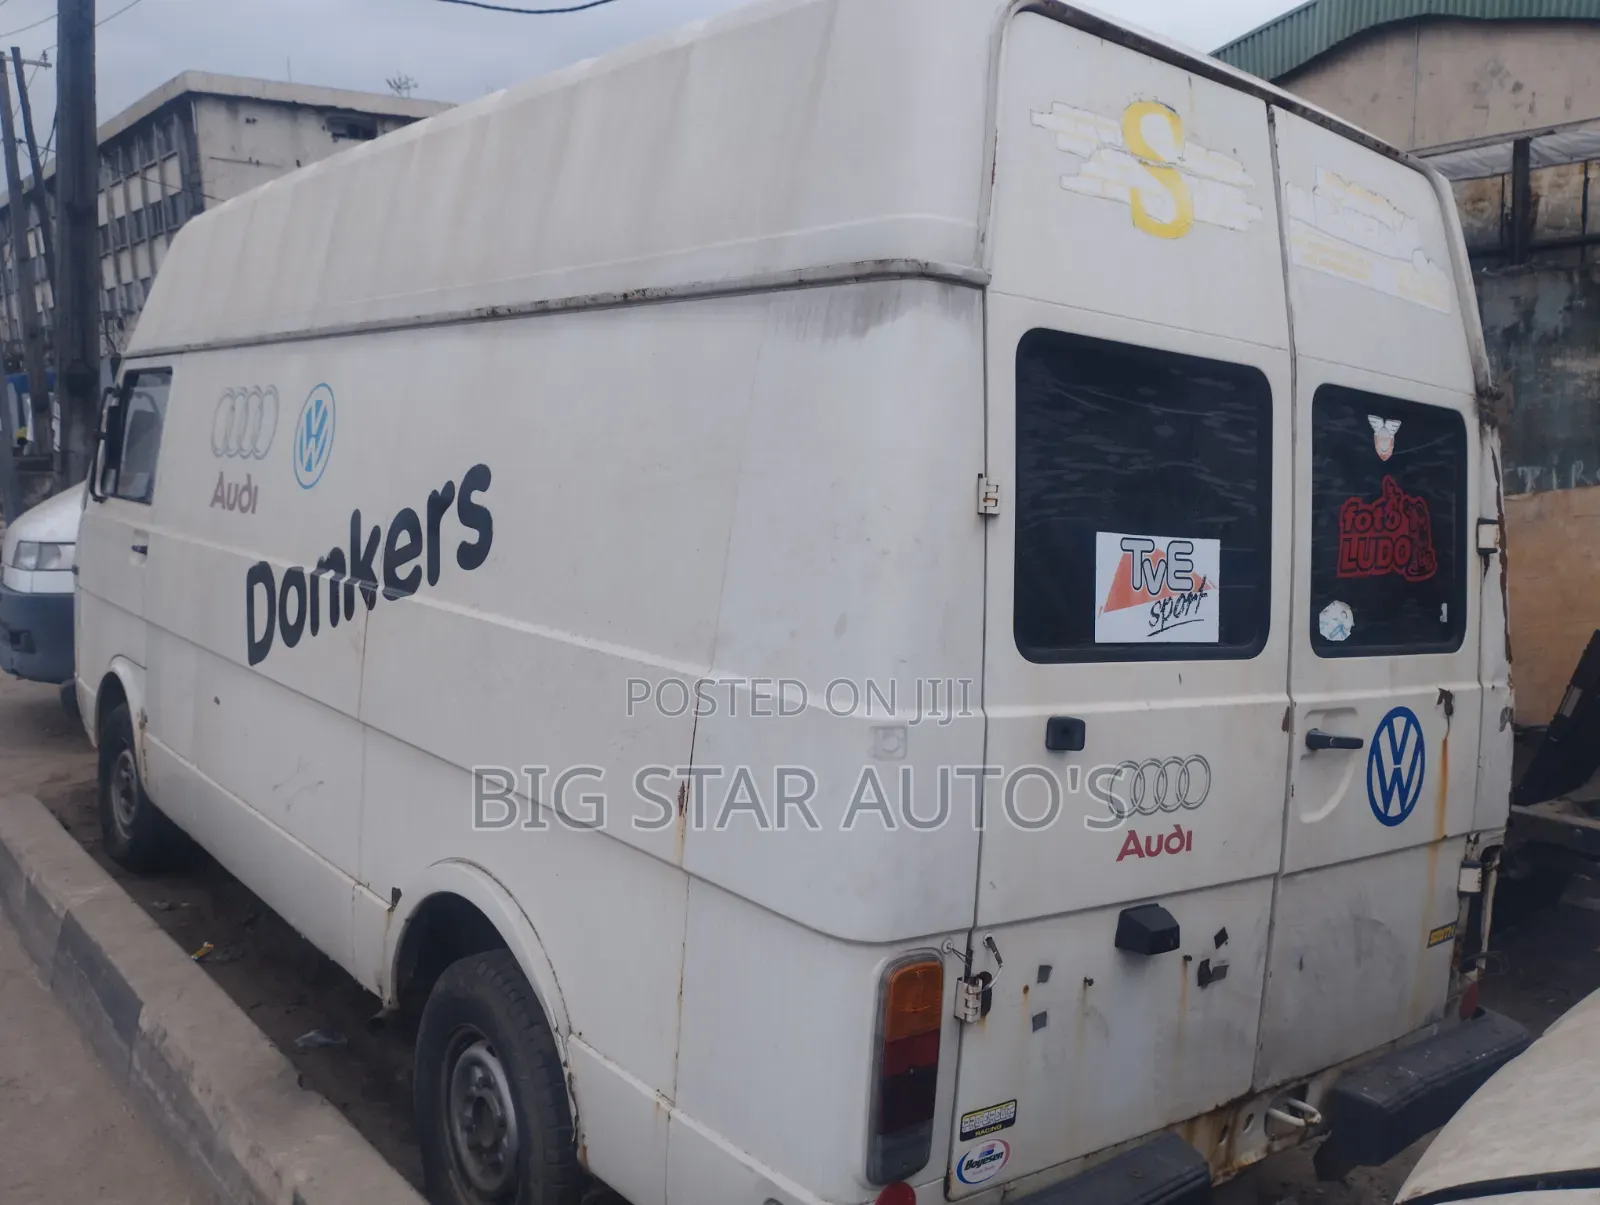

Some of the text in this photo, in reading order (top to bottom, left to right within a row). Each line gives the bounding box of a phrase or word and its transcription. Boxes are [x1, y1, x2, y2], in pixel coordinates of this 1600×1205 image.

[210, 471, 258, 514] Audi
[246, 463, 493, 666] Donkers
[1340, 535, 1412, 574] LUDO
[1116, 824, 1193, 862] Audi
[964, 1151, 1004, 1171] Boyesen
